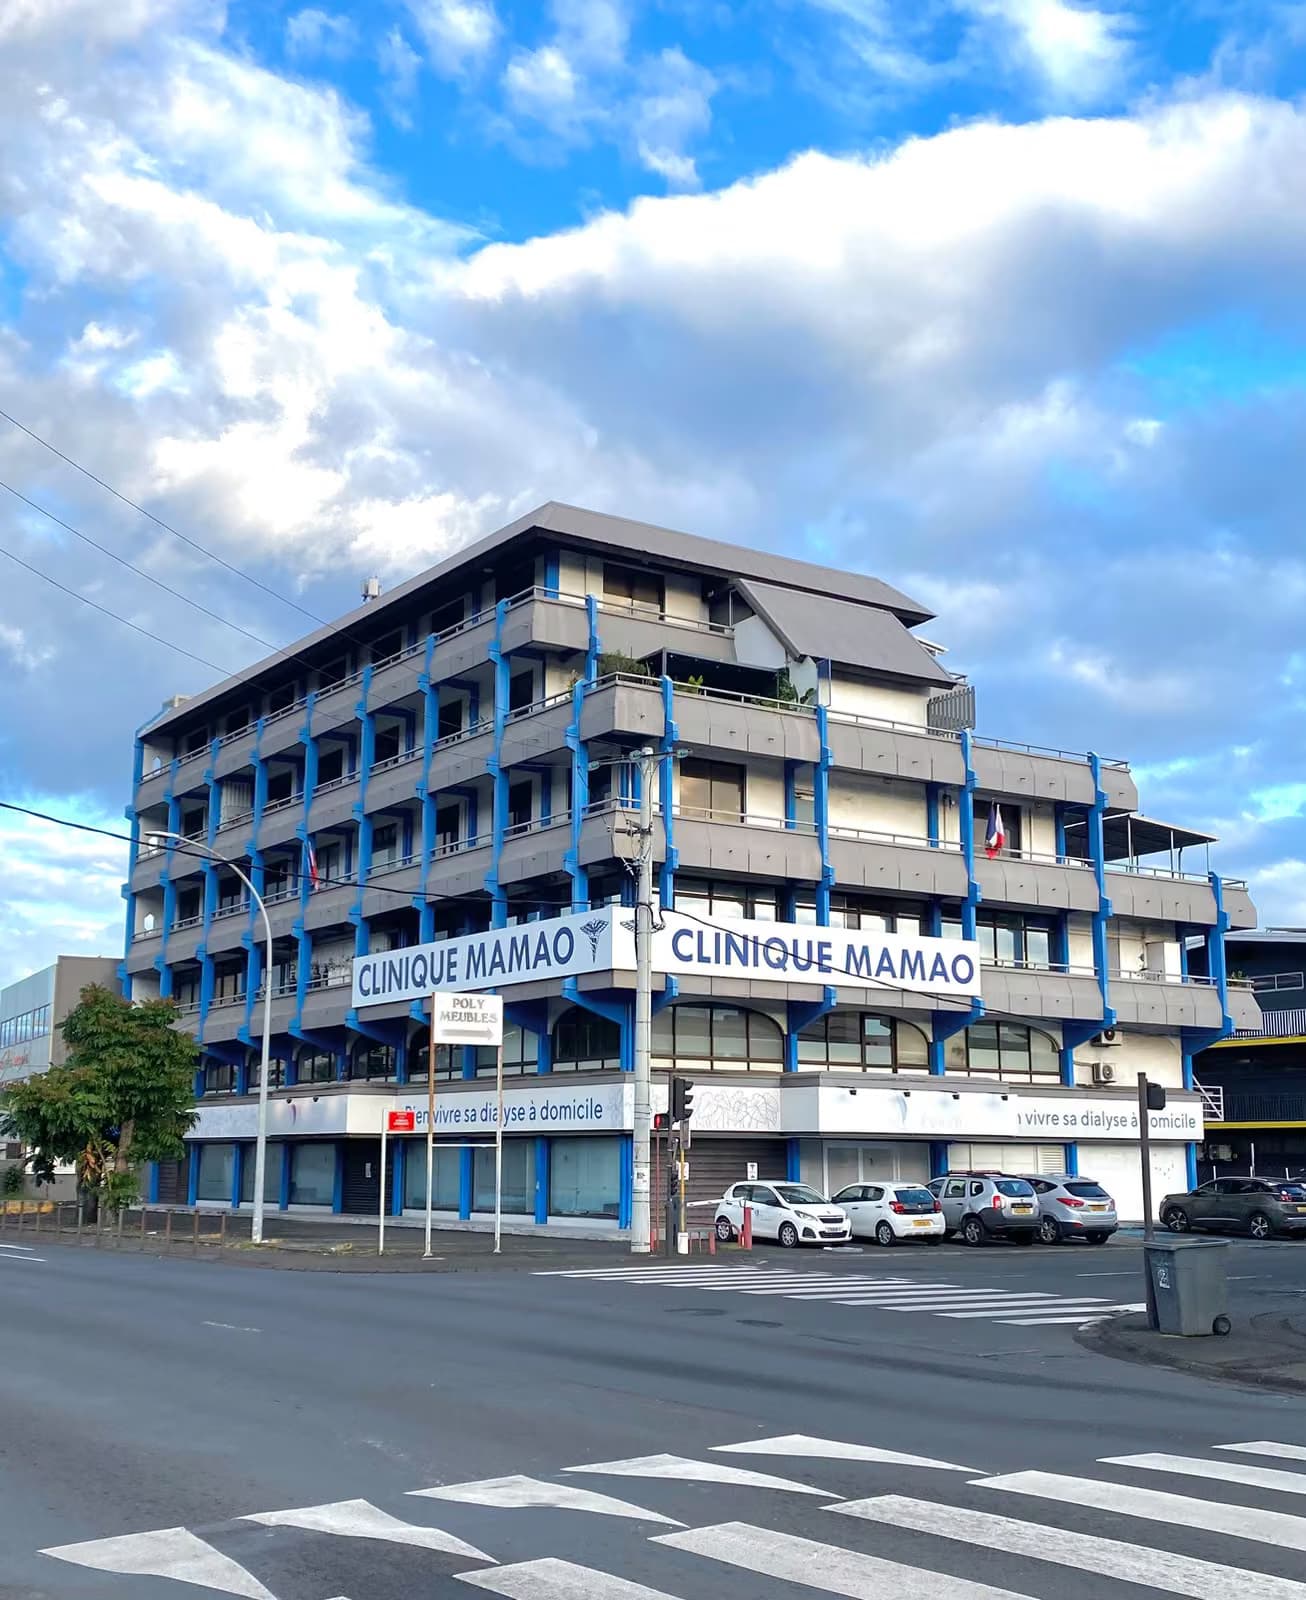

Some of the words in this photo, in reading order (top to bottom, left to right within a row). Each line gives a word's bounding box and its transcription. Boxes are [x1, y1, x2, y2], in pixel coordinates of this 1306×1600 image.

[358, 947, 458, 997] CLINIQUE
[466, 926, 575, 980] MAMAO
[671, 928, 832, 973] CLINIQUE
[845, 943, 975, 985] MAMAO
[440, 1010, 498, 1024] MEUBLES
[452, 998, 486, 1010] POLY
[432, 1104, 461, 1124] vivre
[463, 1107, 477, 1122] sa
[480, 1101, 526, 1128] diayse
[528, 1099, 537, 1121] à
[540, 1097, 603, 1121] domicile
[1025, 1109, 1060, 1126] vivre
[1063, 1112, 1077, 1126] sa
[1080, 1110, 1128, 1131] dialyse
[1130, 1111, 1138, 1127] à
[1149, 1112, 1196, 1129] omicile
